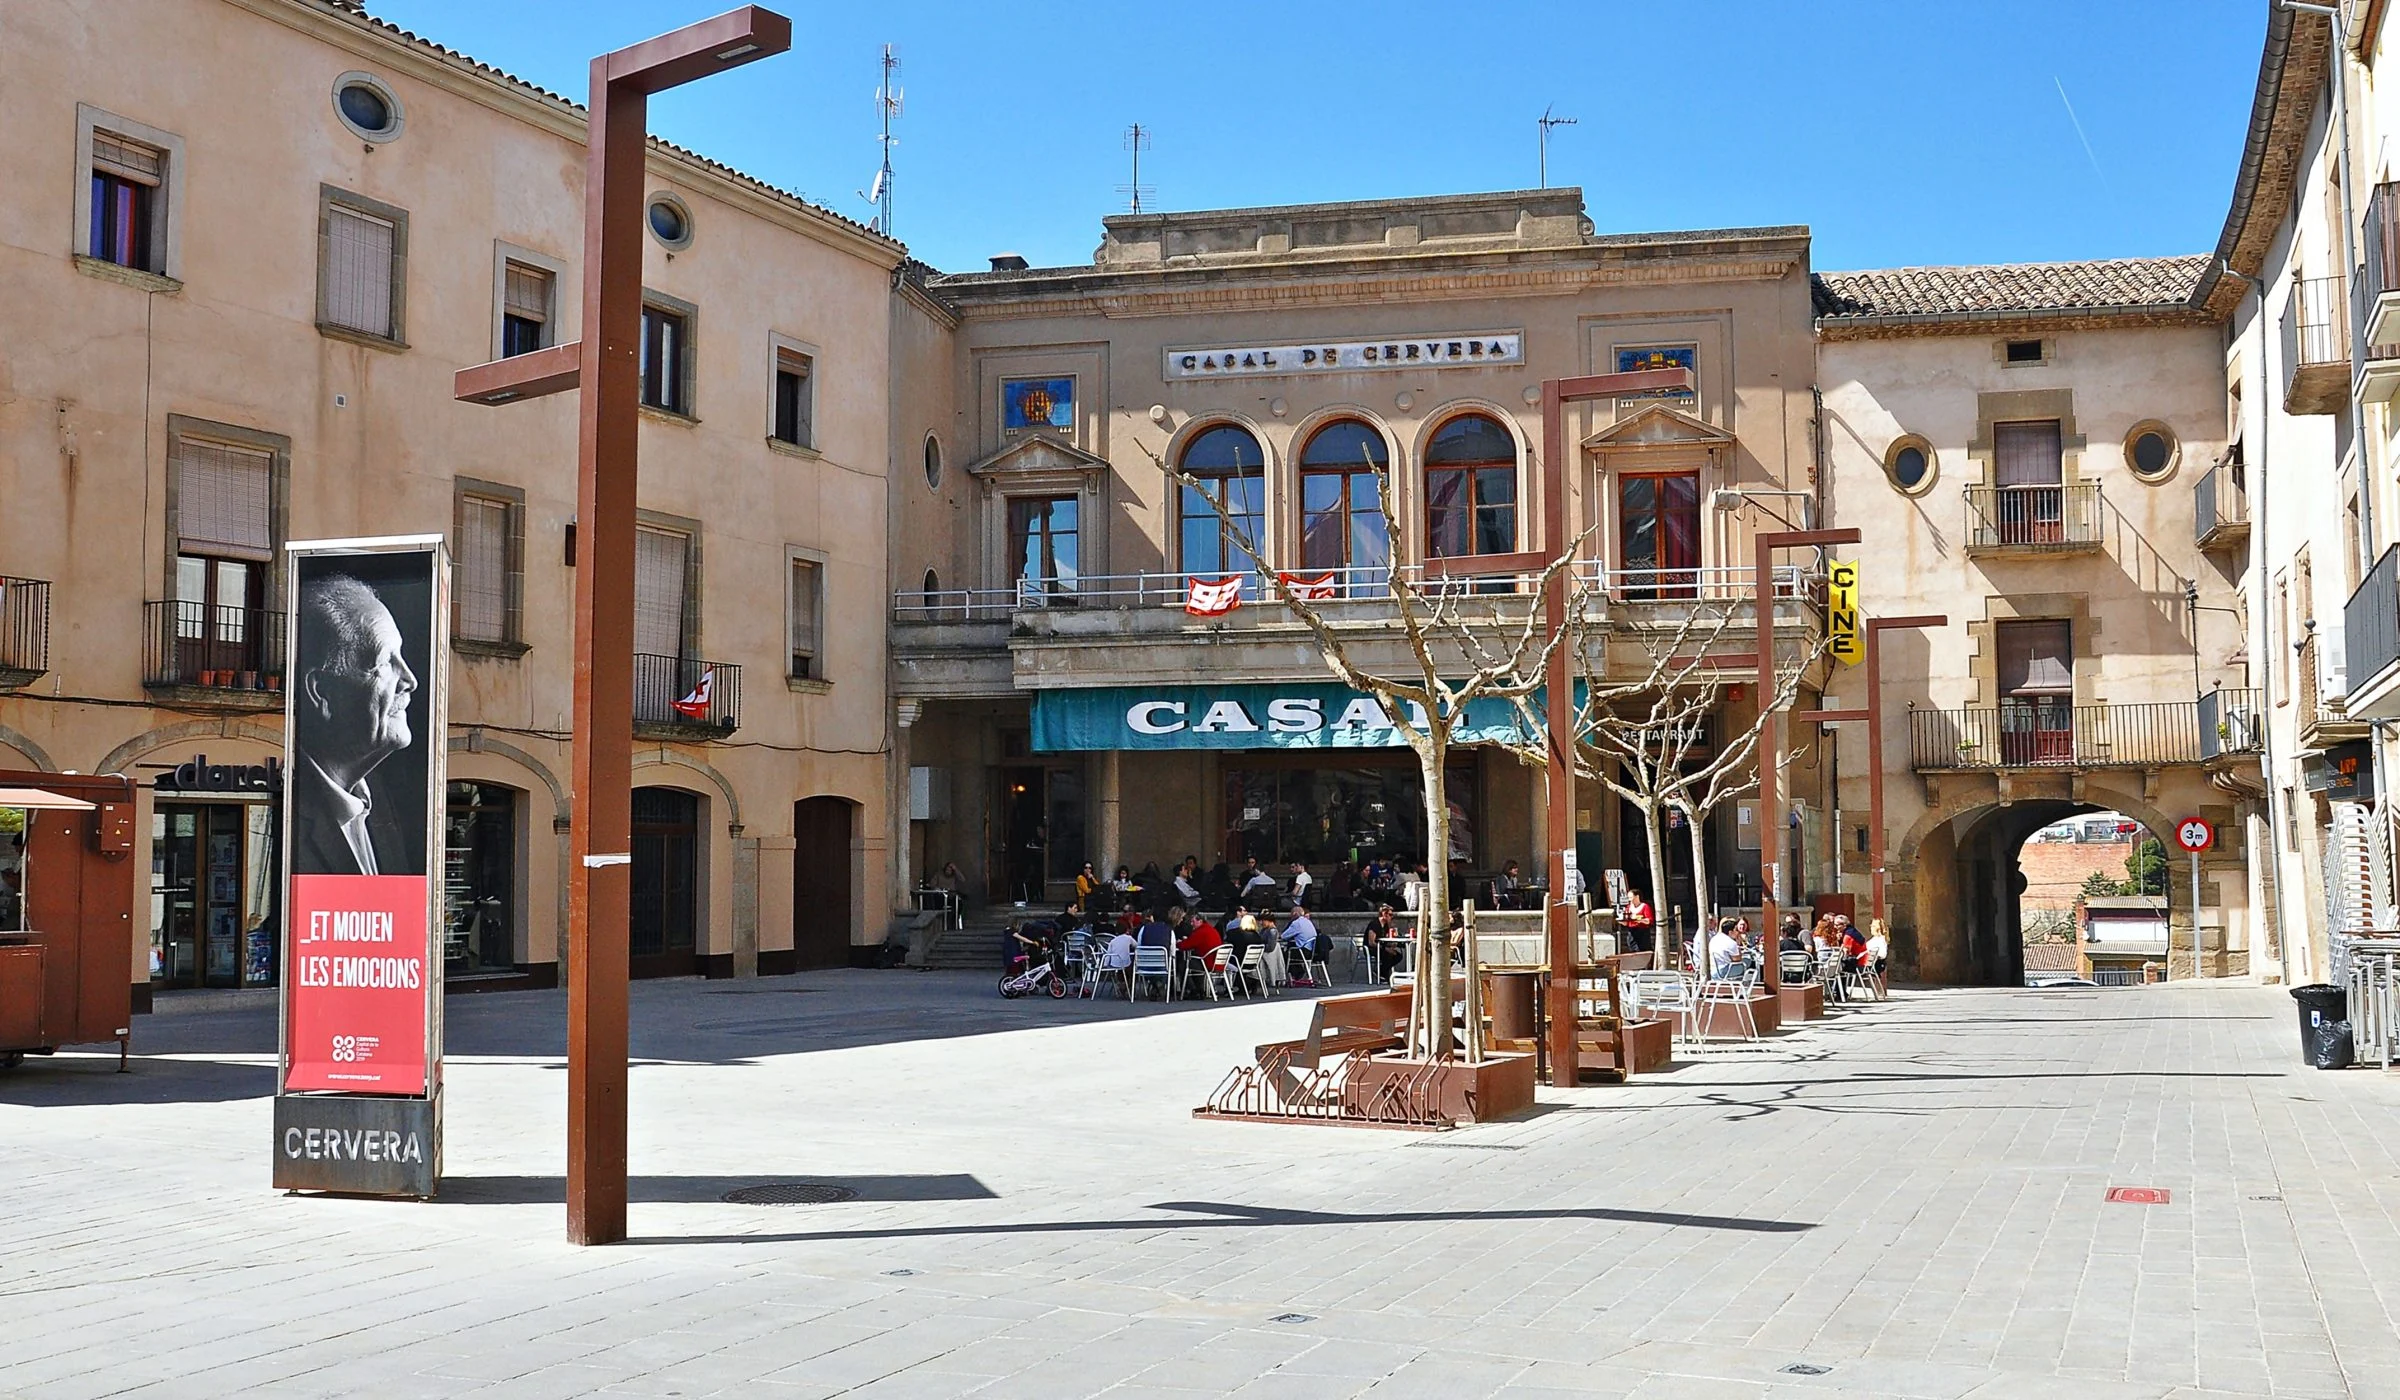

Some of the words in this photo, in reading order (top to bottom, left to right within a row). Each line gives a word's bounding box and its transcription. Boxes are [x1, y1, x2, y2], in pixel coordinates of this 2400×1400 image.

[1181, 351, 1277, 370] CASAL
[1302, 348, 1338, 364] DE
[1362, 341, 1505, 361] CERVERA
[1833, 567, 1855, 654] CINE
[1126, 698, 1466, 734] CASAL
[333, 911, 393, 942] MOUEN
[300, 955, 330, 987] LES
[332, 956, 420, 989] EMOCIONS
[284, 1127, 423, 1164] CERVERA
